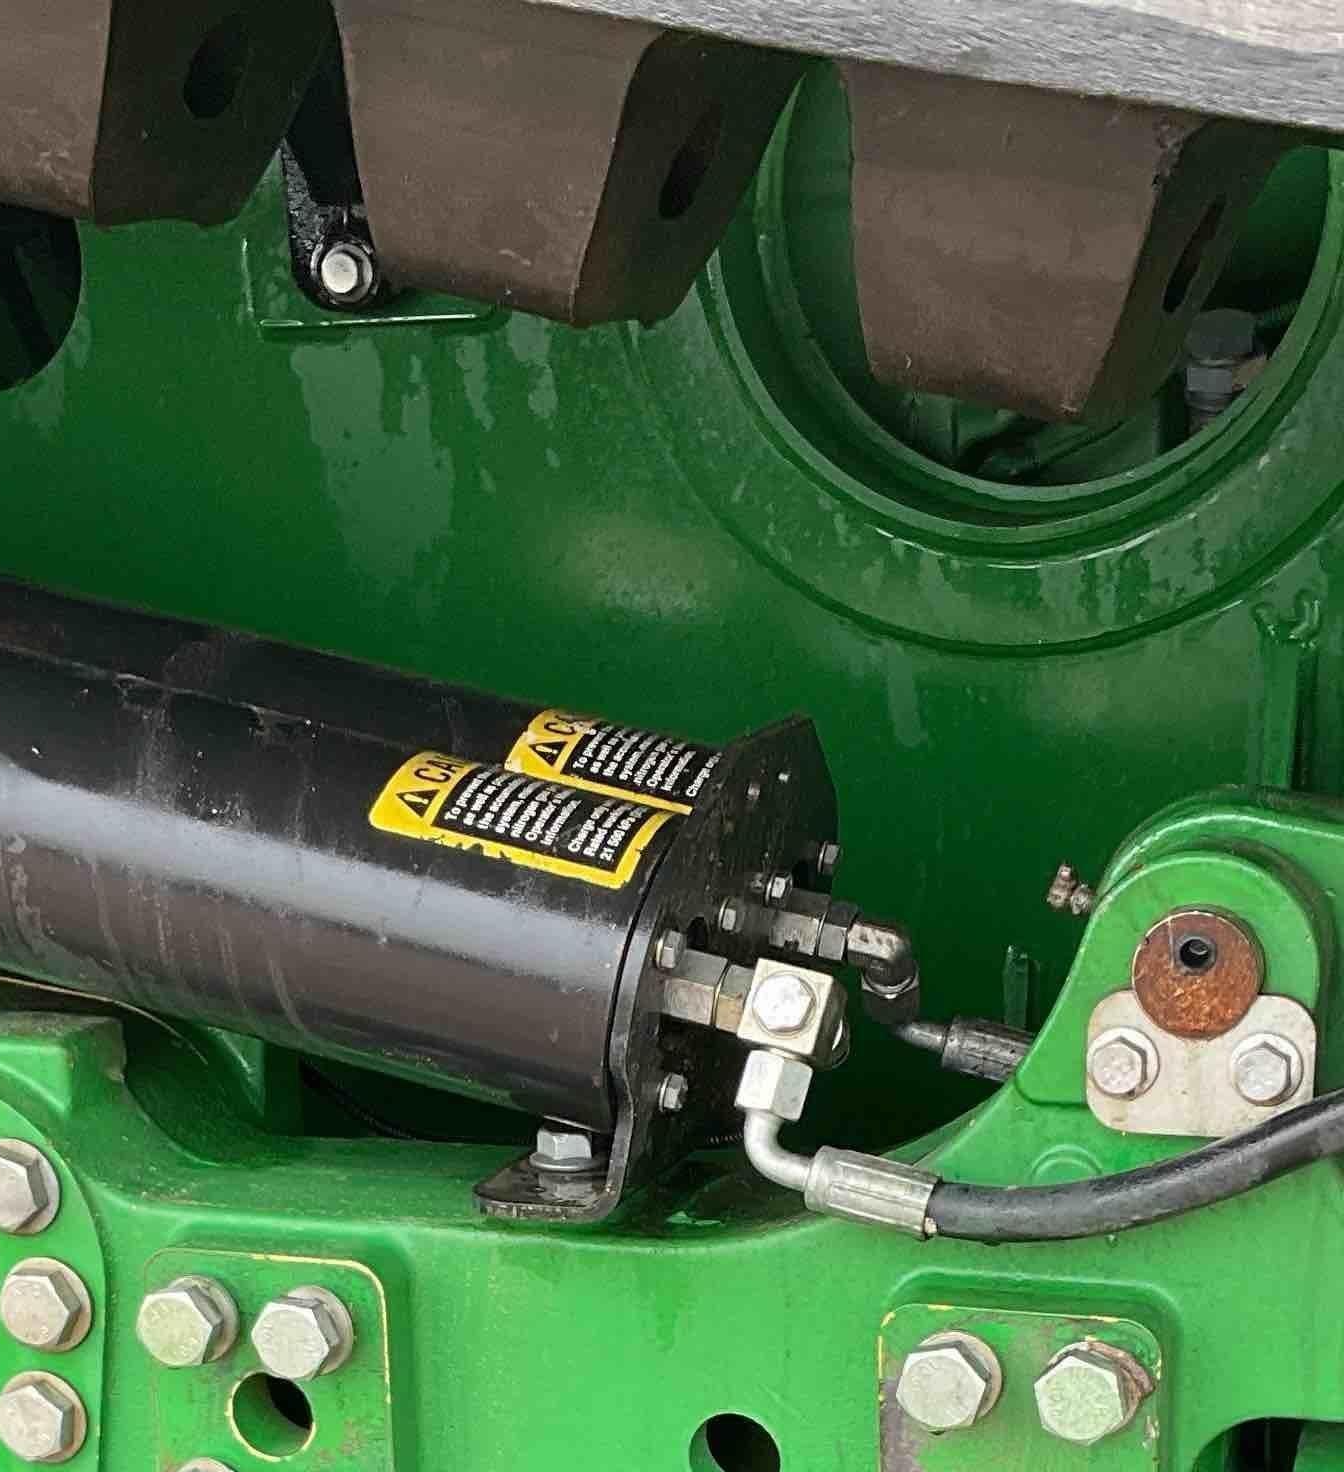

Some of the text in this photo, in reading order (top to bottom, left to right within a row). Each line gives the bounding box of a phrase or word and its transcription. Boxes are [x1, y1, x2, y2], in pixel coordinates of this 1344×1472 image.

[444, 807, 461, 821] To
[477, 812, 494, 829] the
[568, 815, 596, 853] Charge
